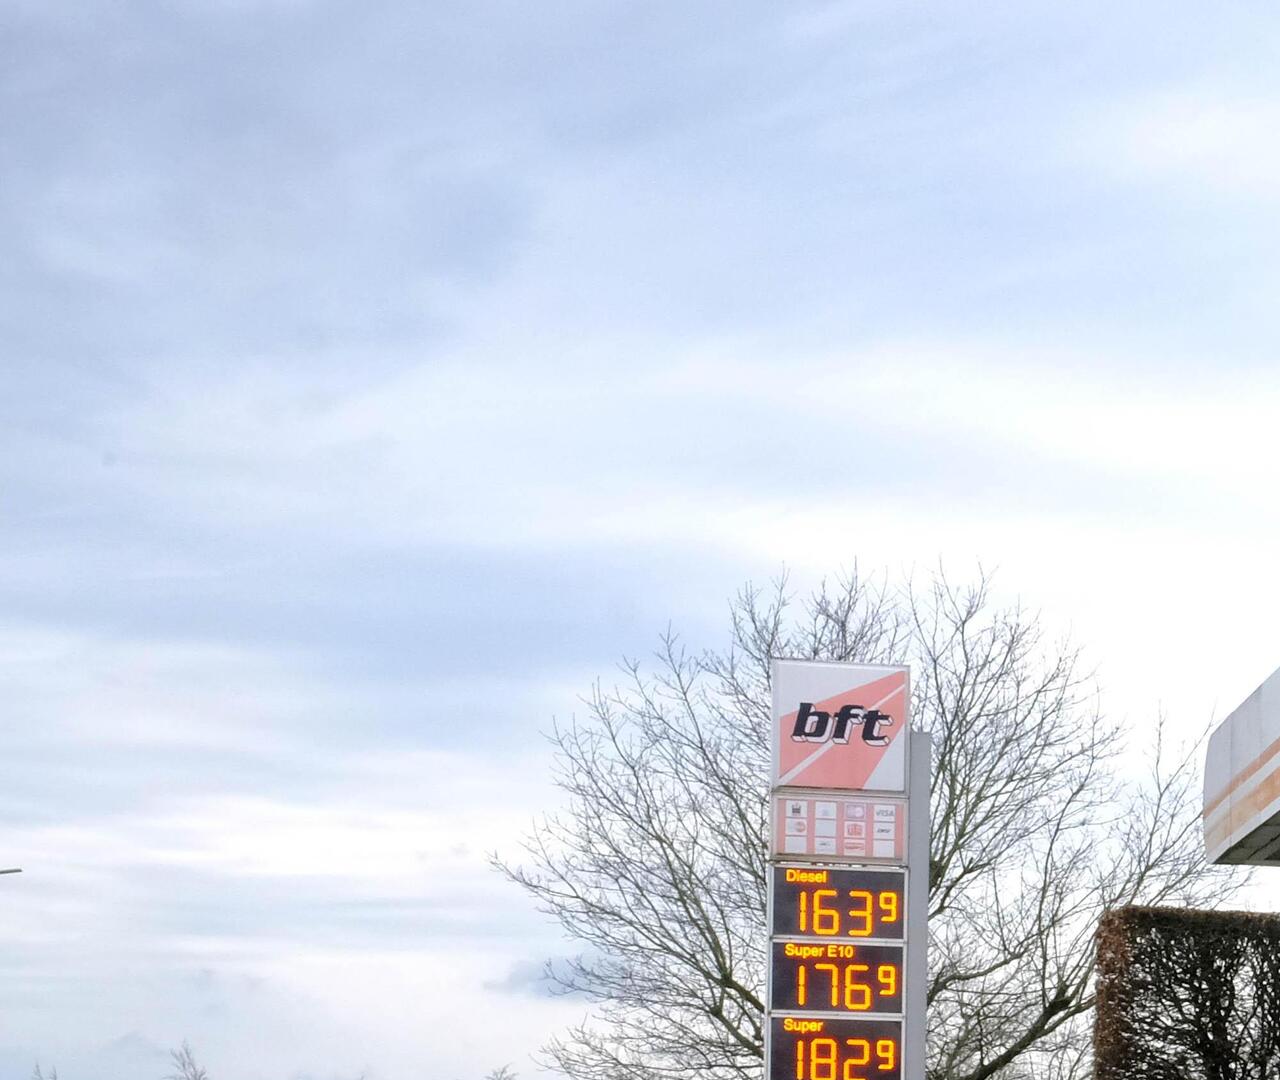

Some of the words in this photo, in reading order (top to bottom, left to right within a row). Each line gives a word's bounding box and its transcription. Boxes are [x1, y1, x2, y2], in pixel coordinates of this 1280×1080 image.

[791, 702, 894, 746] bft
[785, 869, 828, 884] Diesel
[785, 943, 824, 959] Super
[827, 945, 854, 958] E10
[784, 1018, 824, 1033] Super
